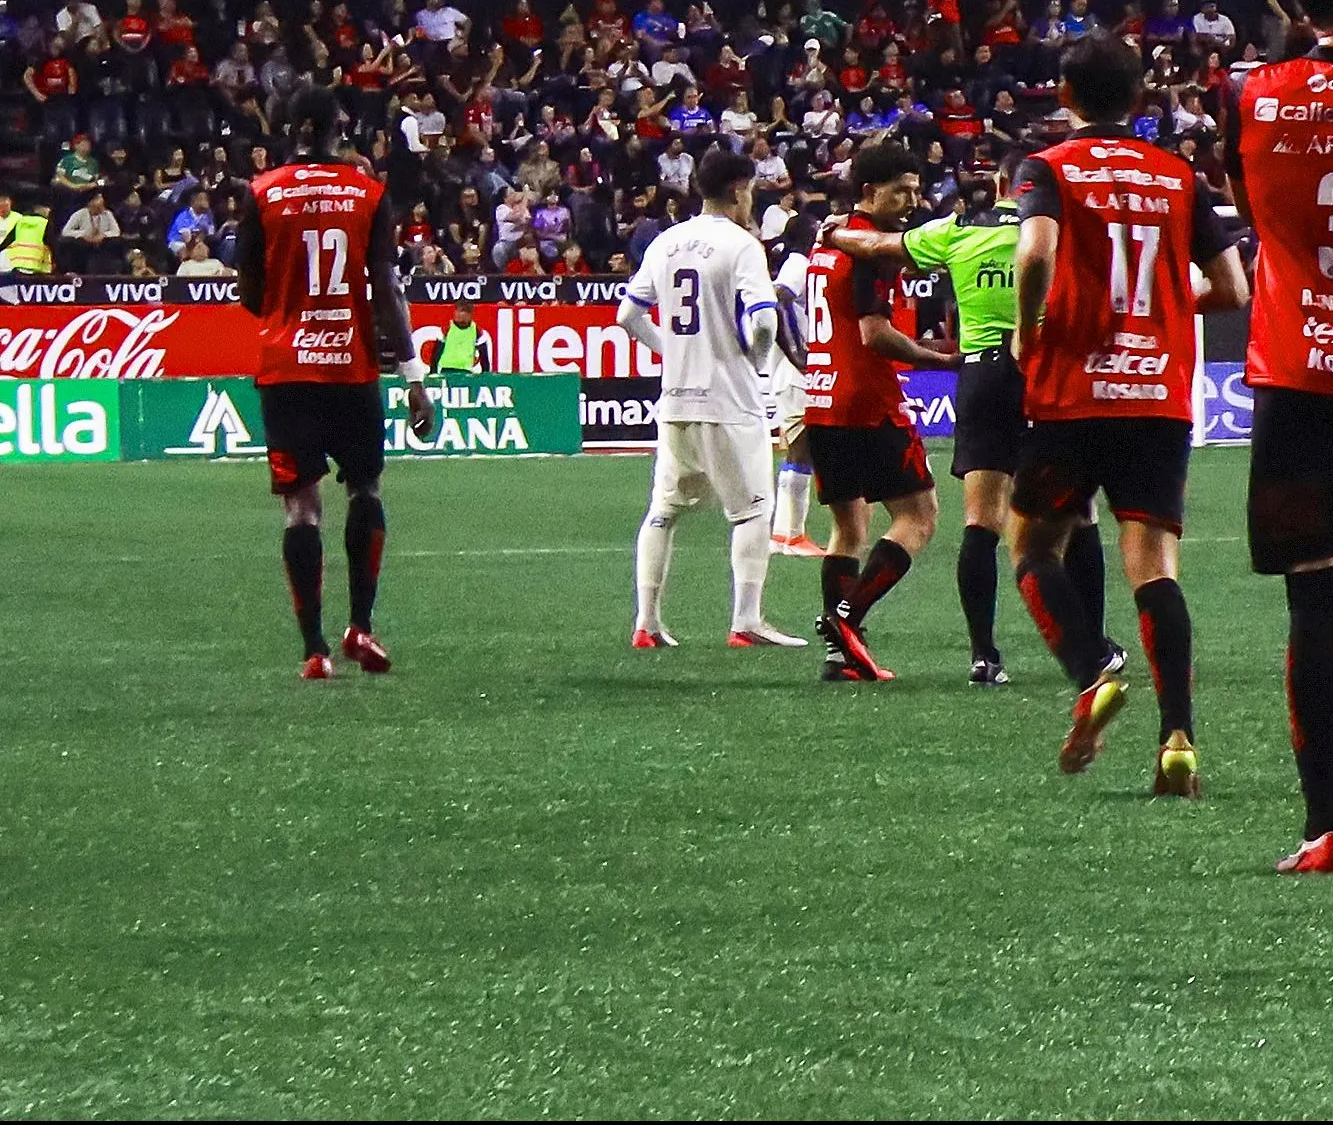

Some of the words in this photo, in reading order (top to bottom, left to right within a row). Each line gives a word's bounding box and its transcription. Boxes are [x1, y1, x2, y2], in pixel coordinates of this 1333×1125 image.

[303, 229, 349, 296] 12
[1108, 222, 1160, 317] 17
[671, 269, 700, 335] 3
[292, 327, 354, 347] telcel
